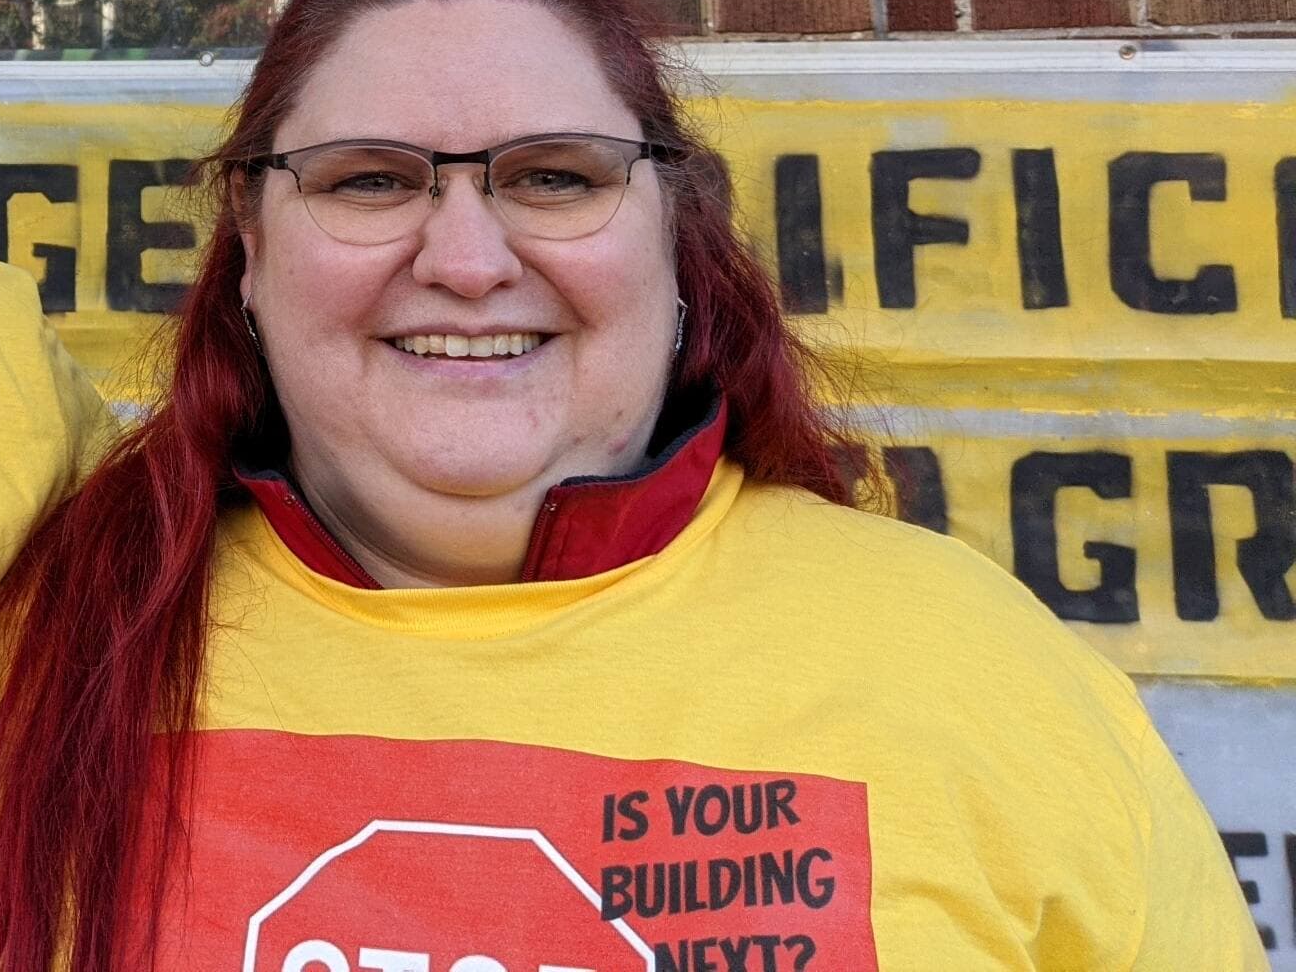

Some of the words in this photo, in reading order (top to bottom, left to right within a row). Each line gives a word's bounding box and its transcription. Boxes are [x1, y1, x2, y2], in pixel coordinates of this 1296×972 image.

[601, 790, 649, 843] IS
[665, 779, 801, 836] YOUR
[601, 847, 835, 922] BUILDING
